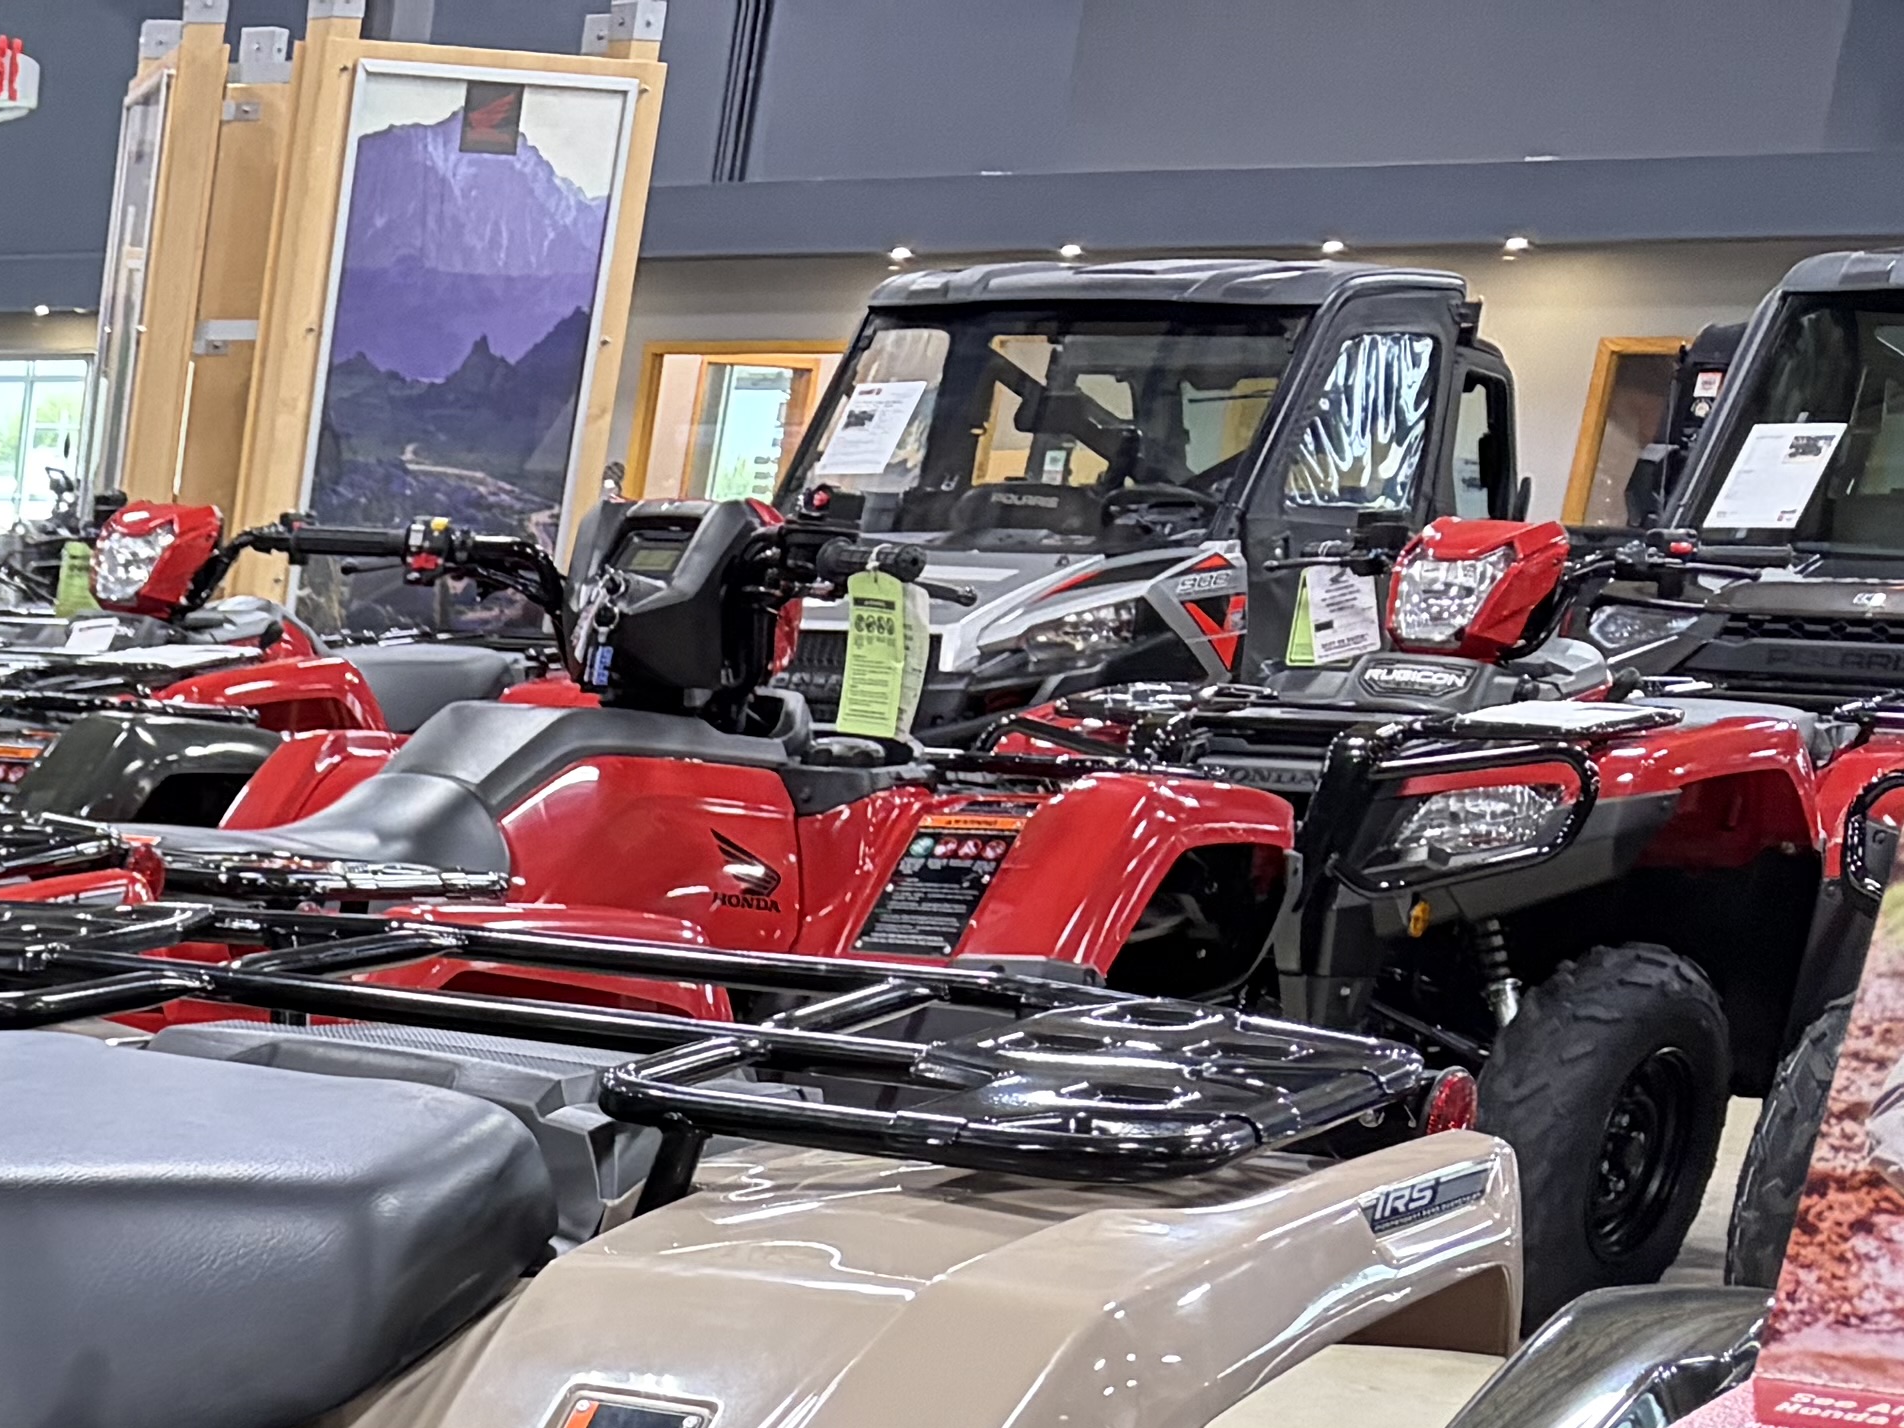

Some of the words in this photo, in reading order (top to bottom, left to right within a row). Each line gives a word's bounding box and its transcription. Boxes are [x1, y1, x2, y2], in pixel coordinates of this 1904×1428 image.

[990, 493, 1060, 508] POLARIS
[1363, 667, 1467, 688] RUBICON
[713, 891, 781, 912] HONDA
[1372, 1179, 1436, 1221] IRS
[1789, 1392, 1859, 1409] See
[1774, 1400, 1891, 1426] Honda
